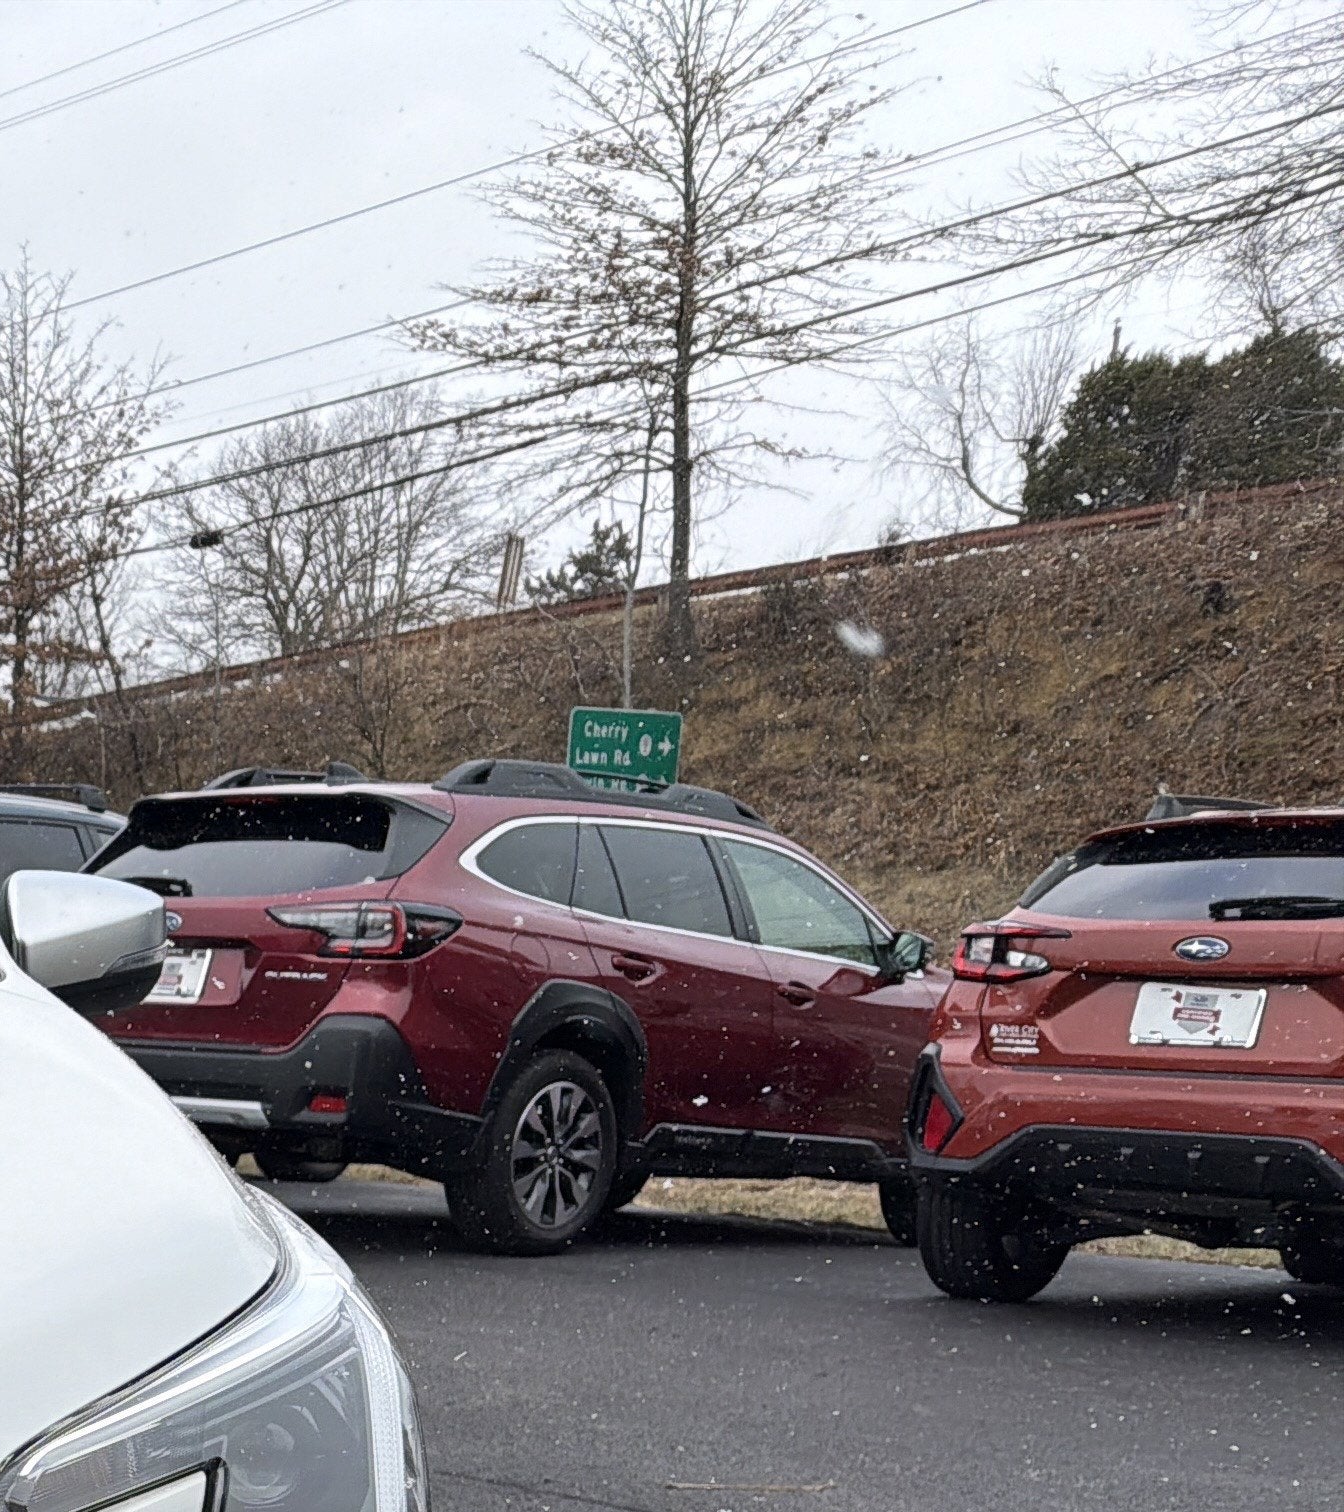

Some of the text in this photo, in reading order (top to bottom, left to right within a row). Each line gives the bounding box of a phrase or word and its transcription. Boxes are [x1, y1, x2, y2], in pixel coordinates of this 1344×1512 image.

[584, 720, 629, 742] Cherry
[575, 747, 631, 766] Lawn Rd
